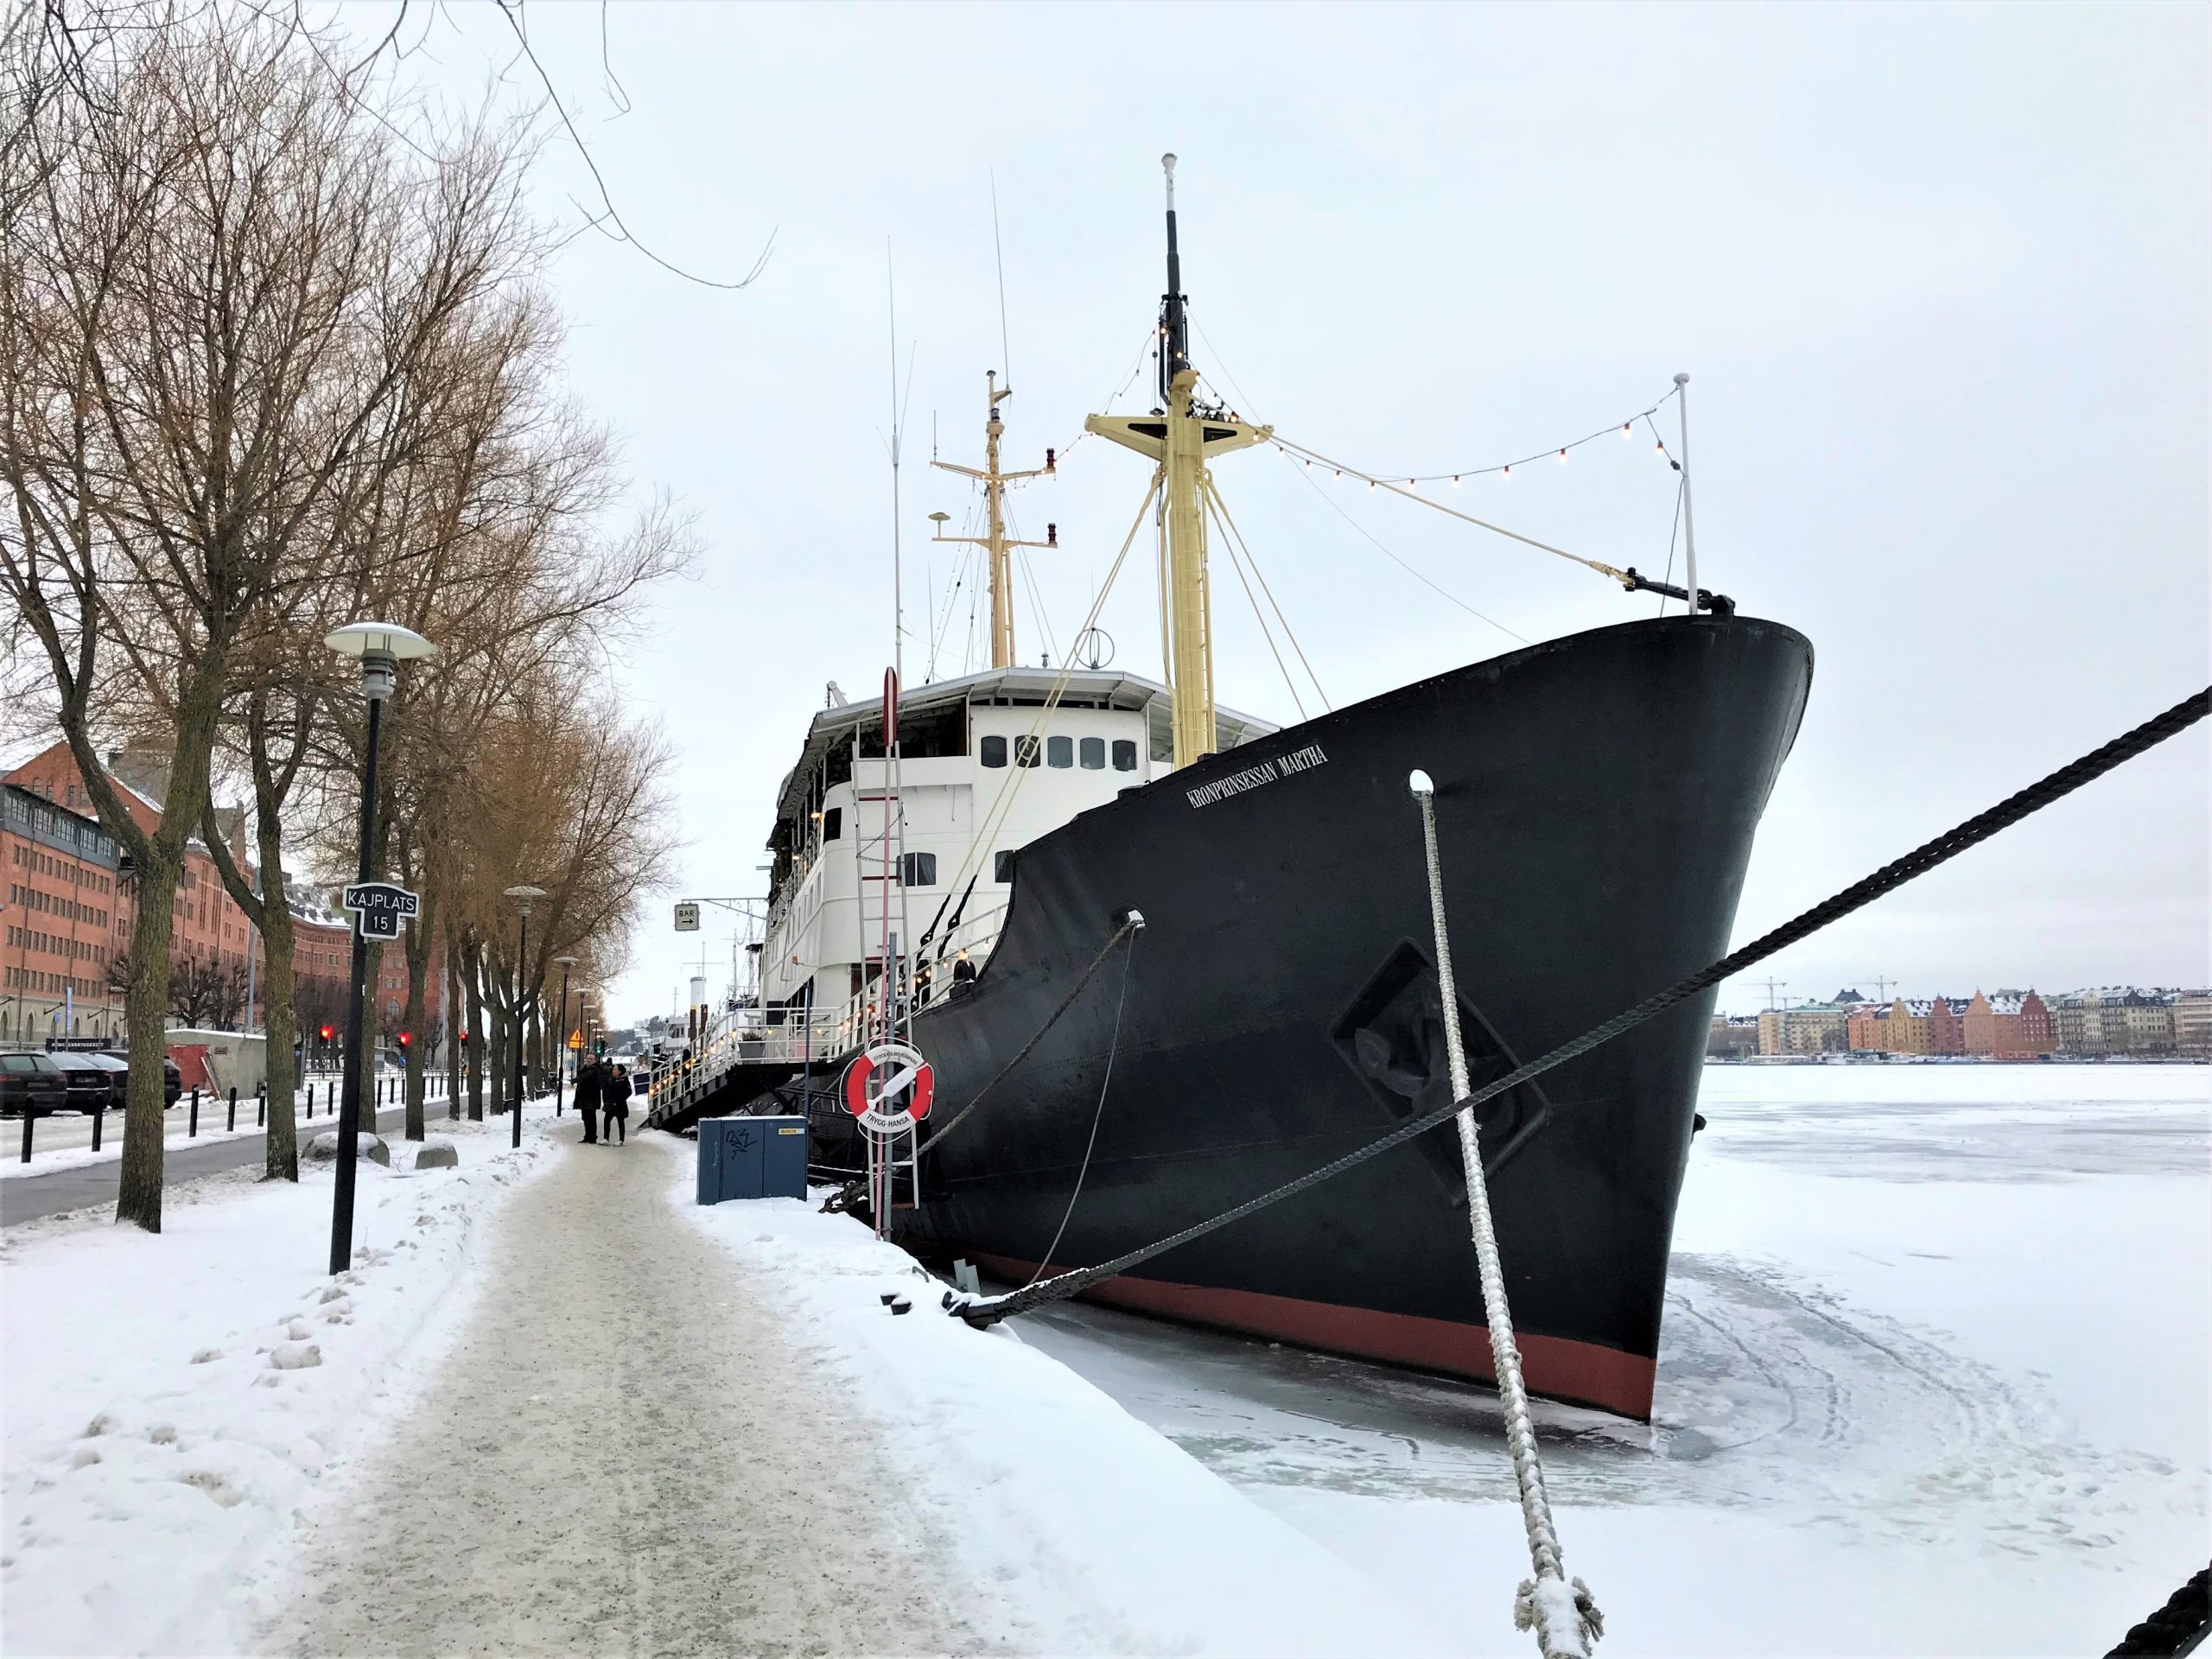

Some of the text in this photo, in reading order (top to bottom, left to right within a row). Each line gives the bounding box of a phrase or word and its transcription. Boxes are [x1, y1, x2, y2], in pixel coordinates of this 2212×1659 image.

[1185, 744, 1329, 809] KRONPRINSESSAN MARTHA
[347, 891, 415, 911] KAJPLATS
[373, 915, 388, 930] 15
